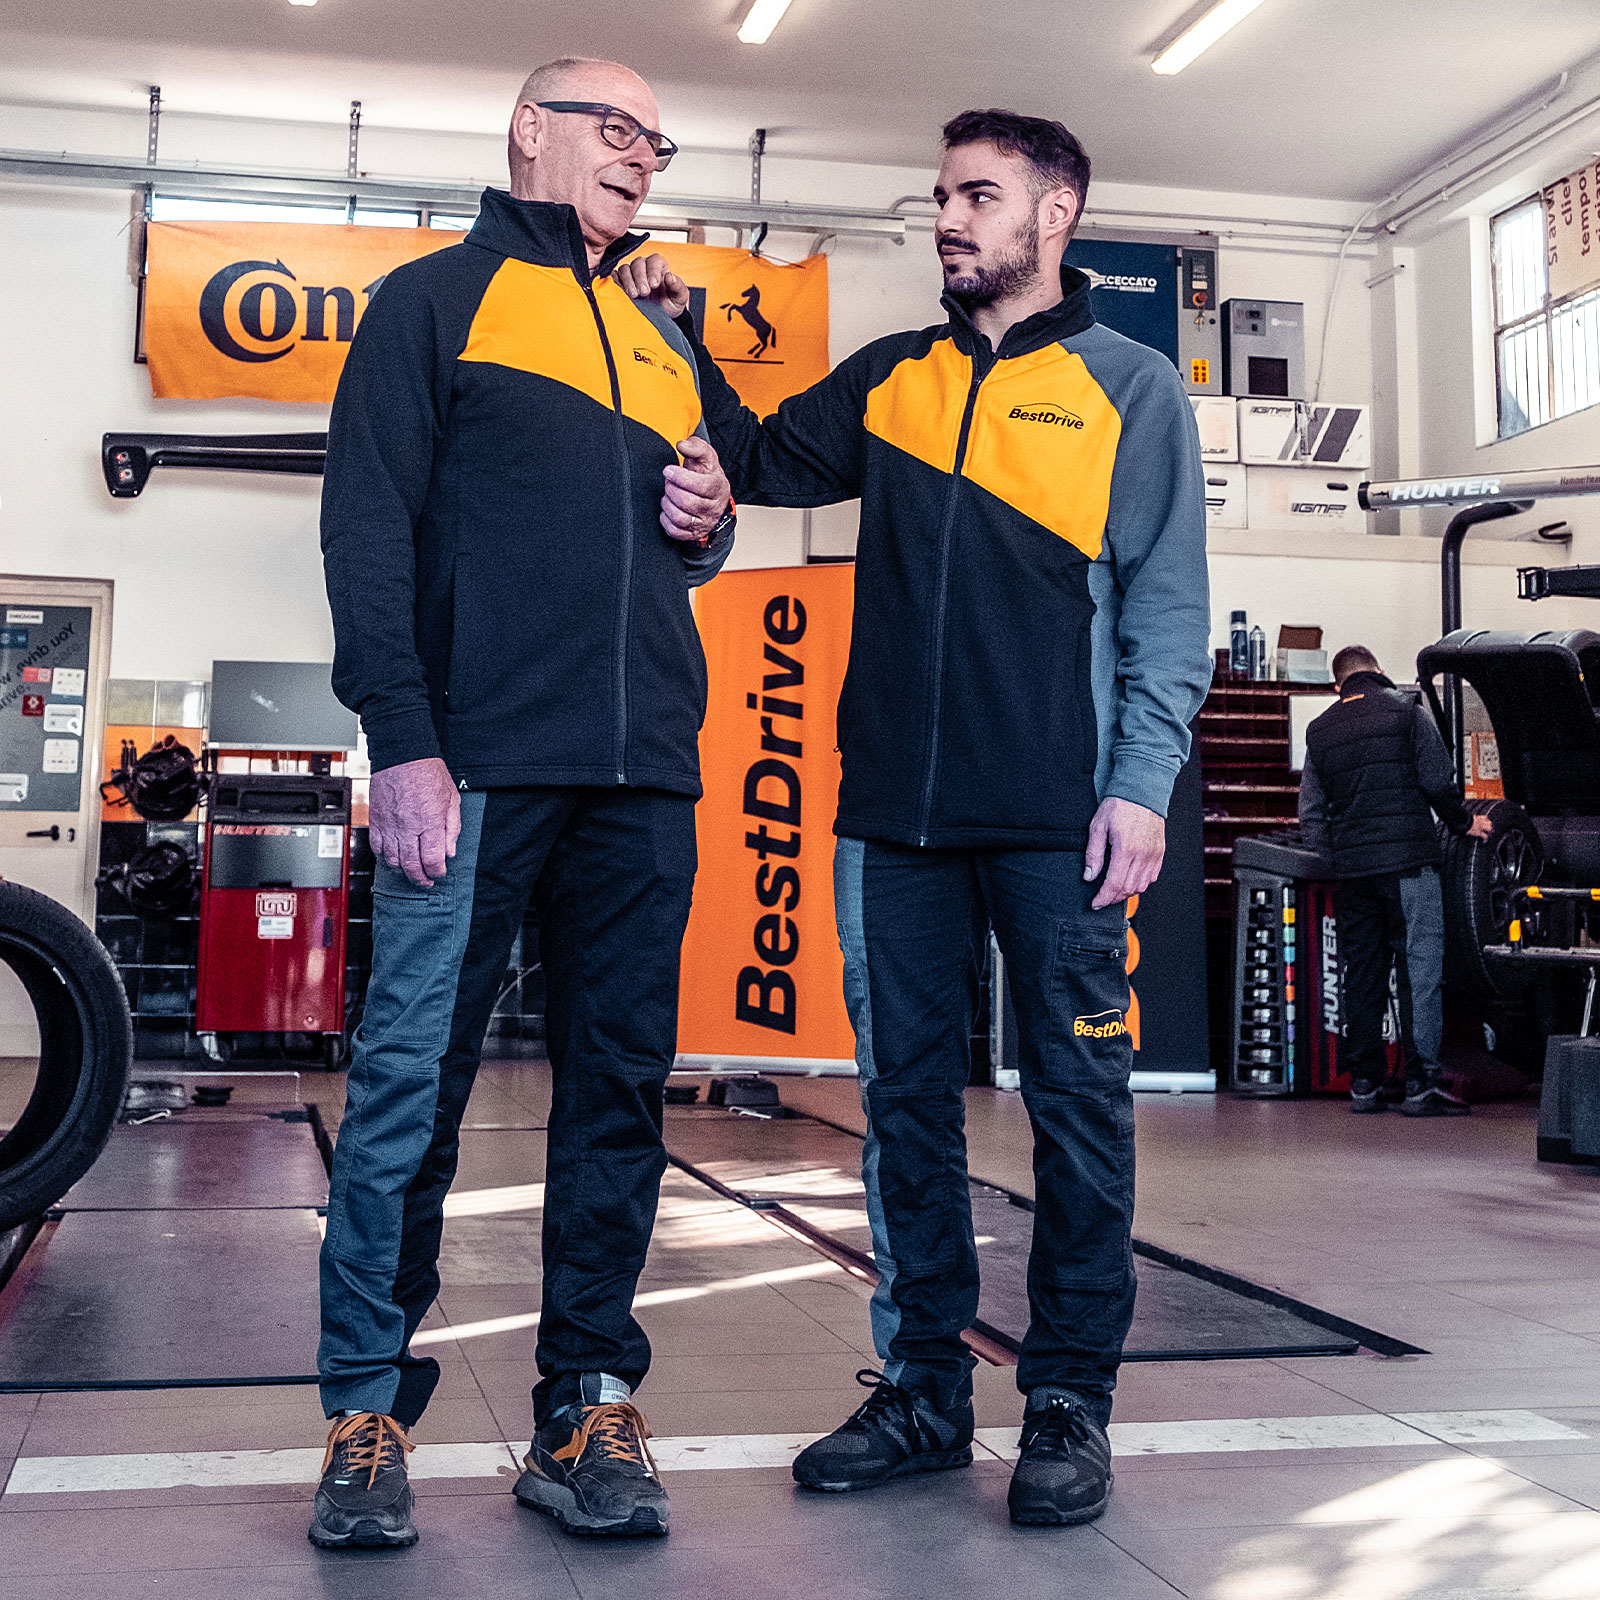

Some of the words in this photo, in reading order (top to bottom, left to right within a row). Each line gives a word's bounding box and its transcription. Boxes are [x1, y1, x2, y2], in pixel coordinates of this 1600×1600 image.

[1106, 275, 1157, 288] CECCATO
[1008, 407, 1084, 430] BestDrive
[1392, 478, 1500, 501] HUNTER
[735, 594, 807, 1036] BestDrive
[1322, 915, 1339, 1035] HUNTER
